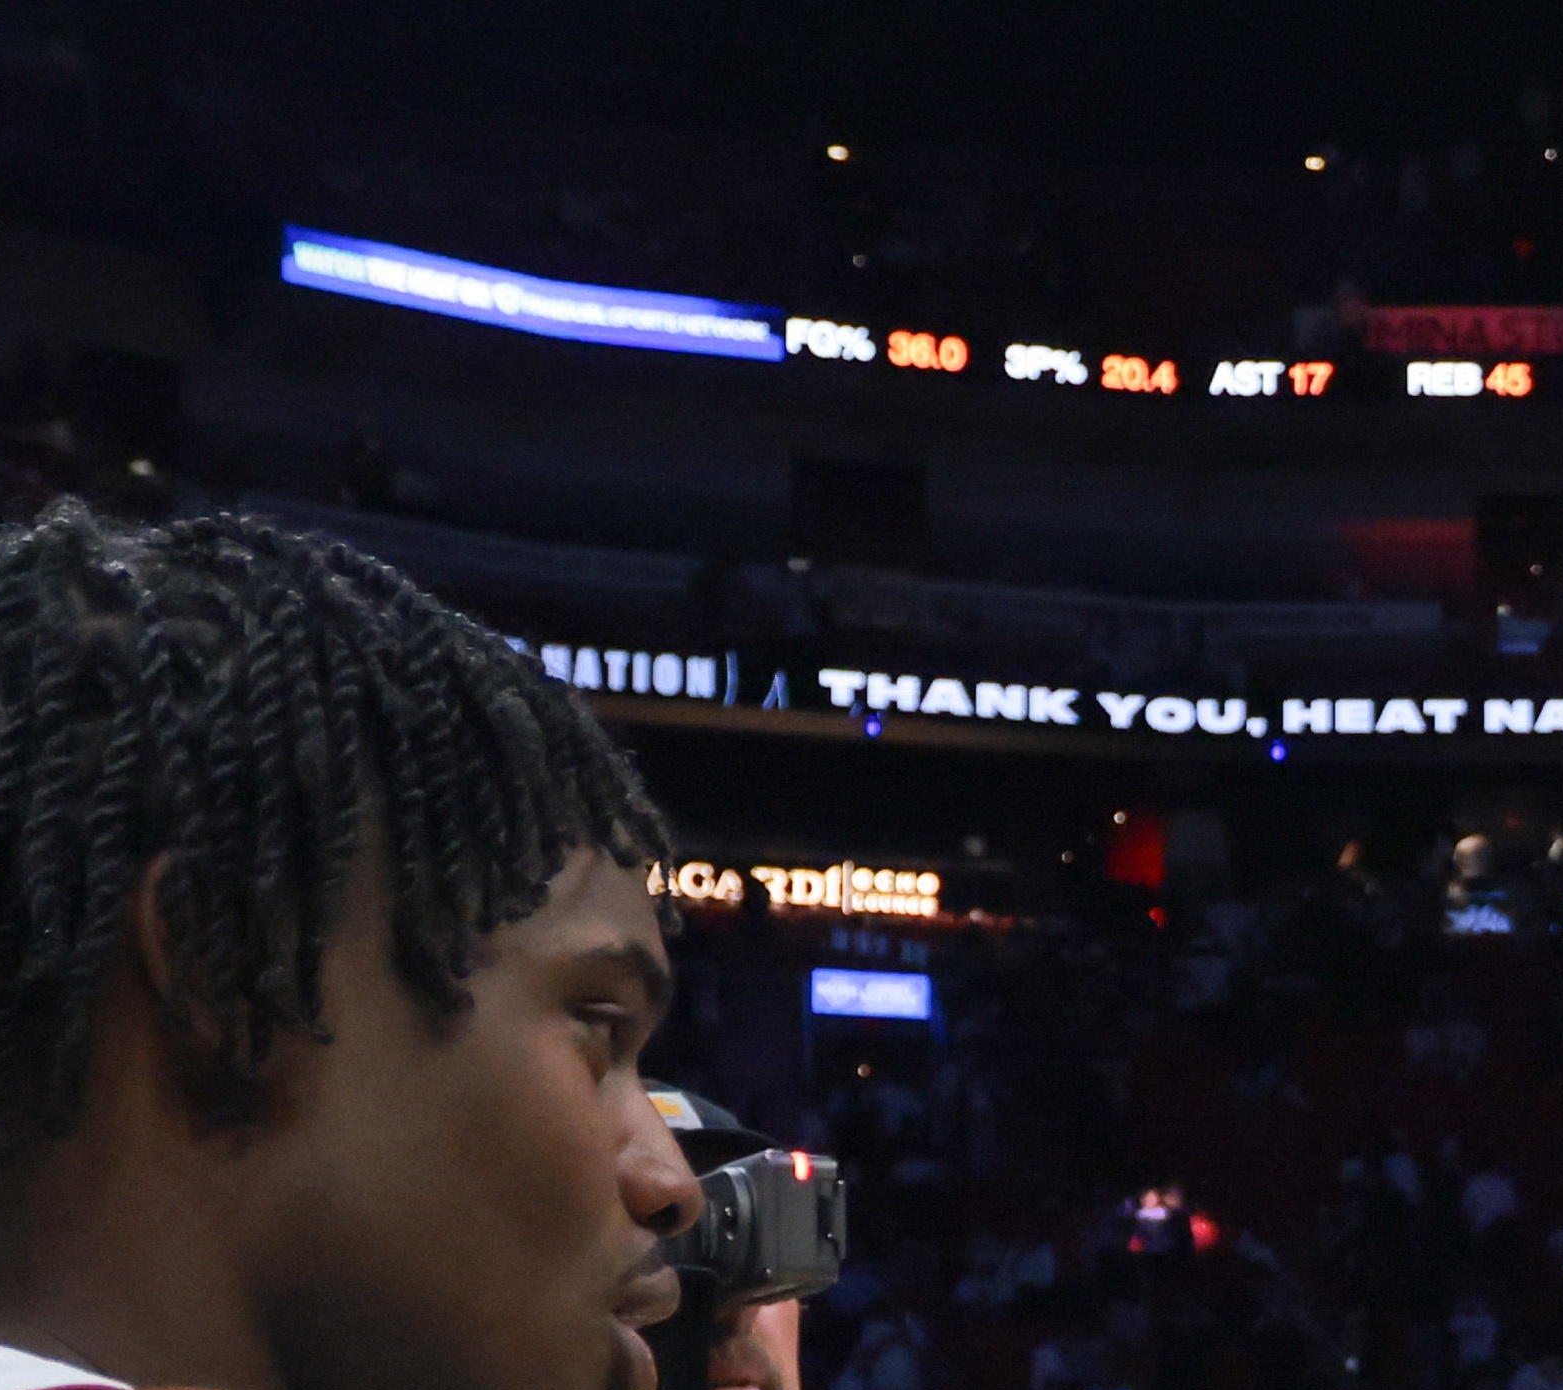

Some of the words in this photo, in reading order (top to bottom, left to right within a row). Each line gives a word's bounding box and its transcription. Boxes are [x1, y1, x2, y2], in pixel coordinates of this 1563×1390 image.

[784, 318, 876, 361] FG%
[888, 330, 968, 372] 36.0
[1005, 344, 1088, 384] 3P%
[1101, 354, 1178, 394] 20.4
[1209, 361, 1285, 396] AST
[1289, 362, 1334, 395] 17
[1407, 362, 1484, 396] REB
[1485, 362, 1533, 397] 45
[541, 645, 715, 697] NATION
[819, 669, 1078, 726] THANK
[1096, 693, 1267, 737] YOU,
[1283, 699, 1467, 733] HEAT
